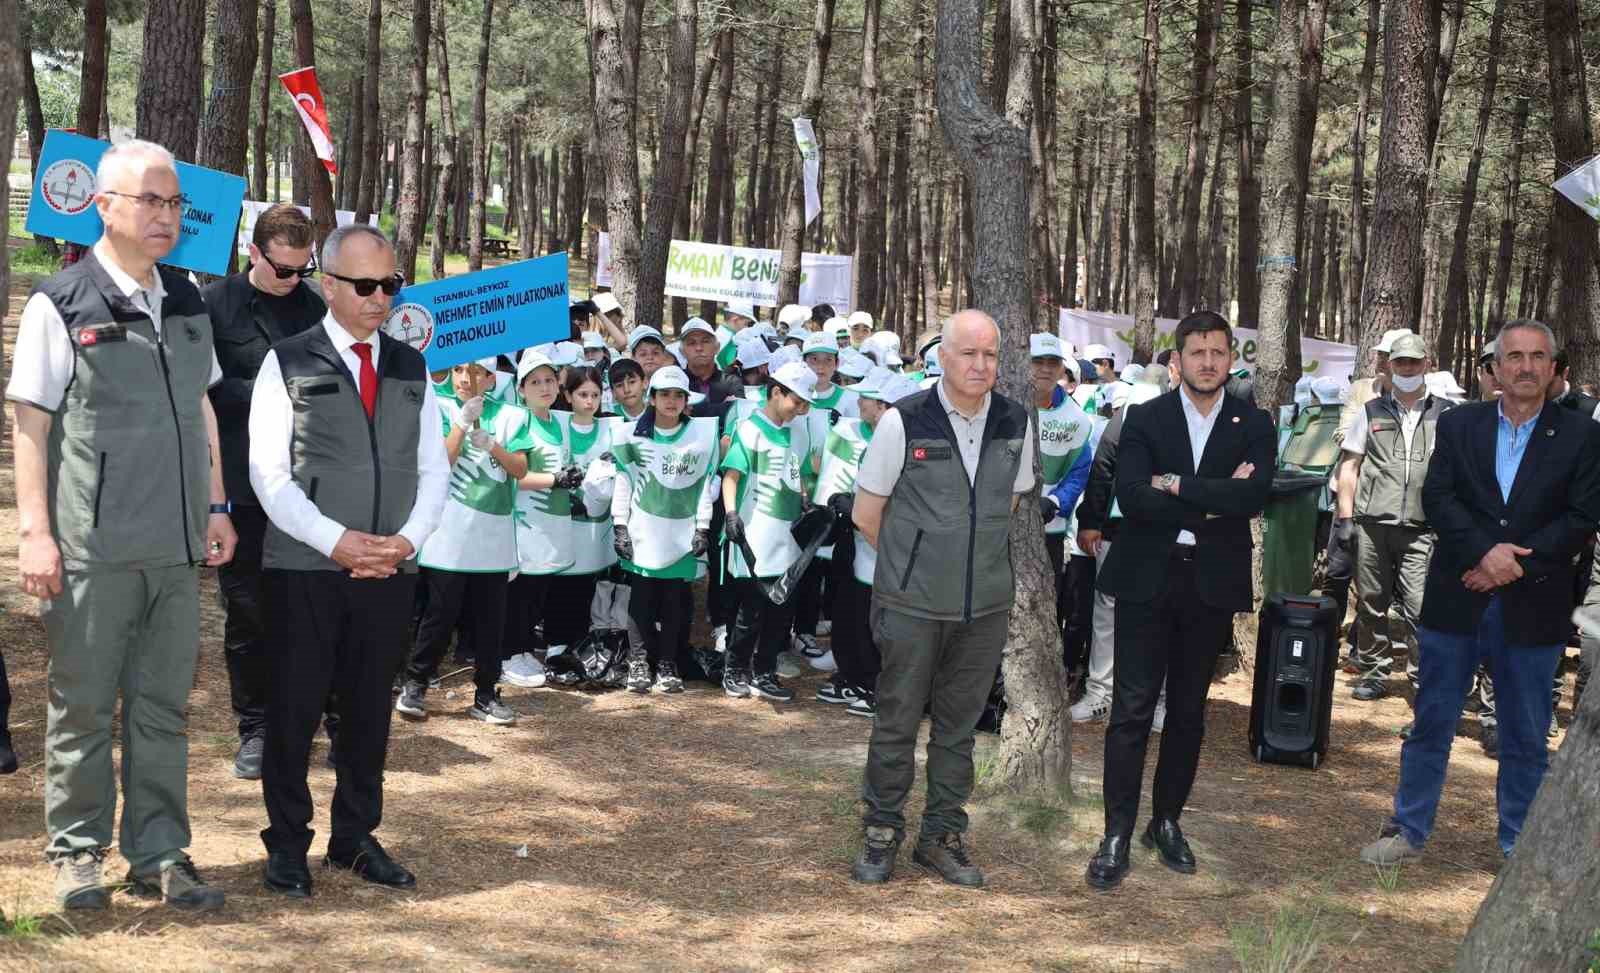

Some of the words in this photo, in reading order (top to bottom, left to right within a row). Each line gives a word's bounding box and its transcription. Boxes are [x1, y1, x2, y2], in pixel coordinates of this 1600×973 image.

[669, 245, 725, 279] RMAN
[435, 303, 479, 327] MEHMET
[506, 281, 567, 310] PULATKONAK
[436, 319, 506, 350] ORTAOKULU
